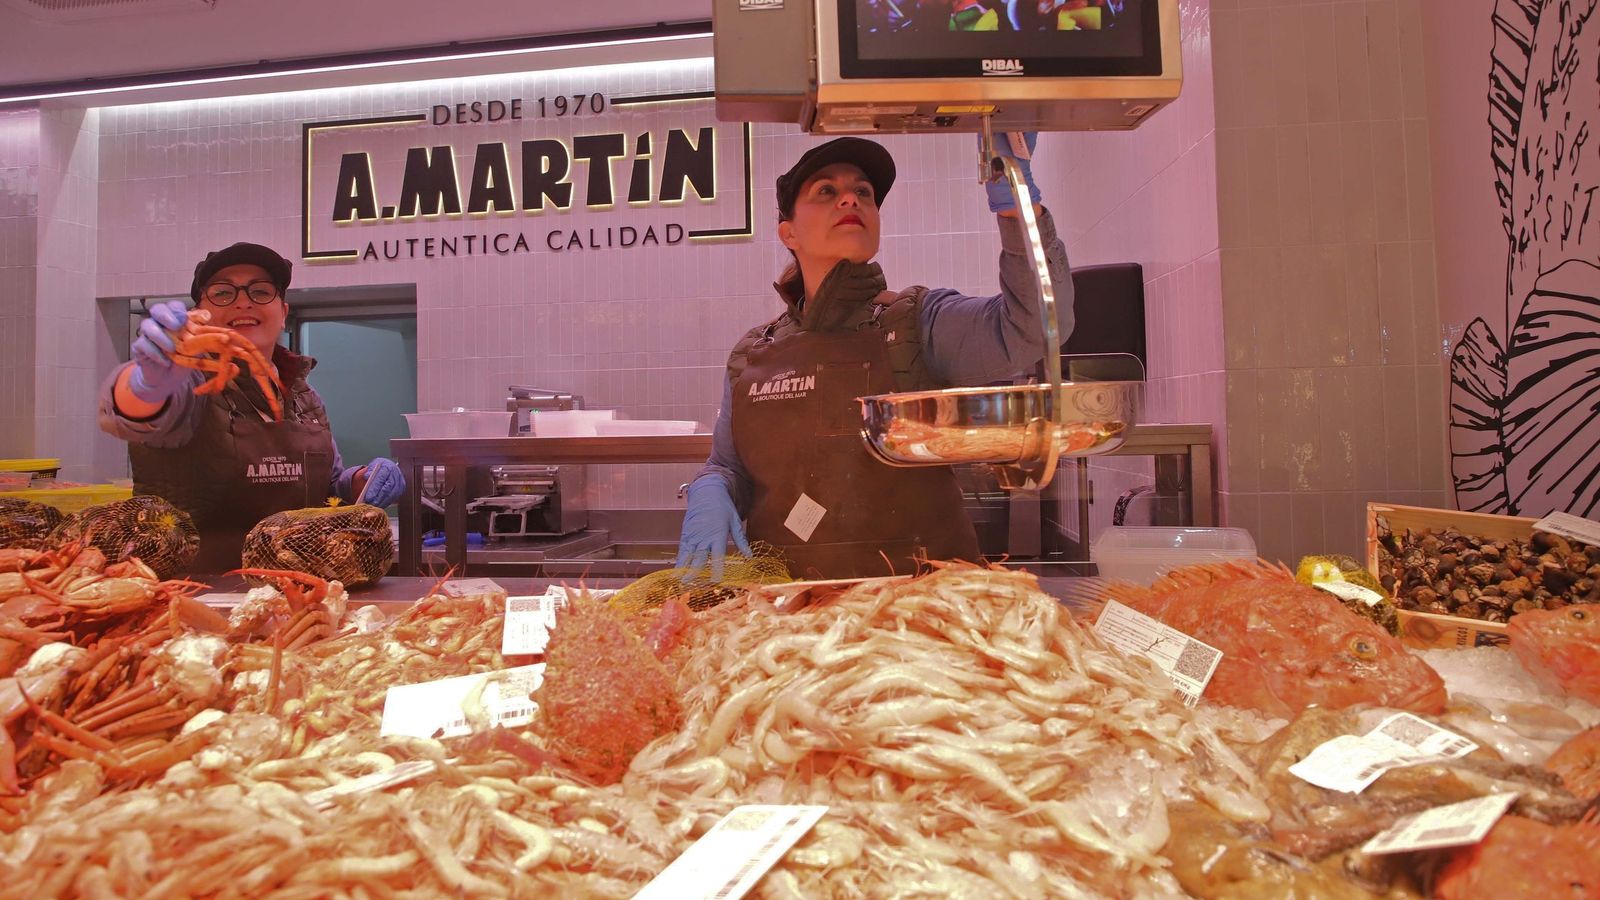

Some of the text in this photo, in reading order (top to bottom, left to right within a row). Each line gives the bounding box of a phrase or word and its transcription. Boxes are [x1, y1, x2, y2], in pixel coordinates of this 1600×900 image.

[982, 59, 1024, 71] DIBAL
[432, 92, 605, 126] DESDE 1970
[363, 223, 684, 261] AUTENTICA CALIDAD
[760, 393, 784, 401] BOUTIQUE
